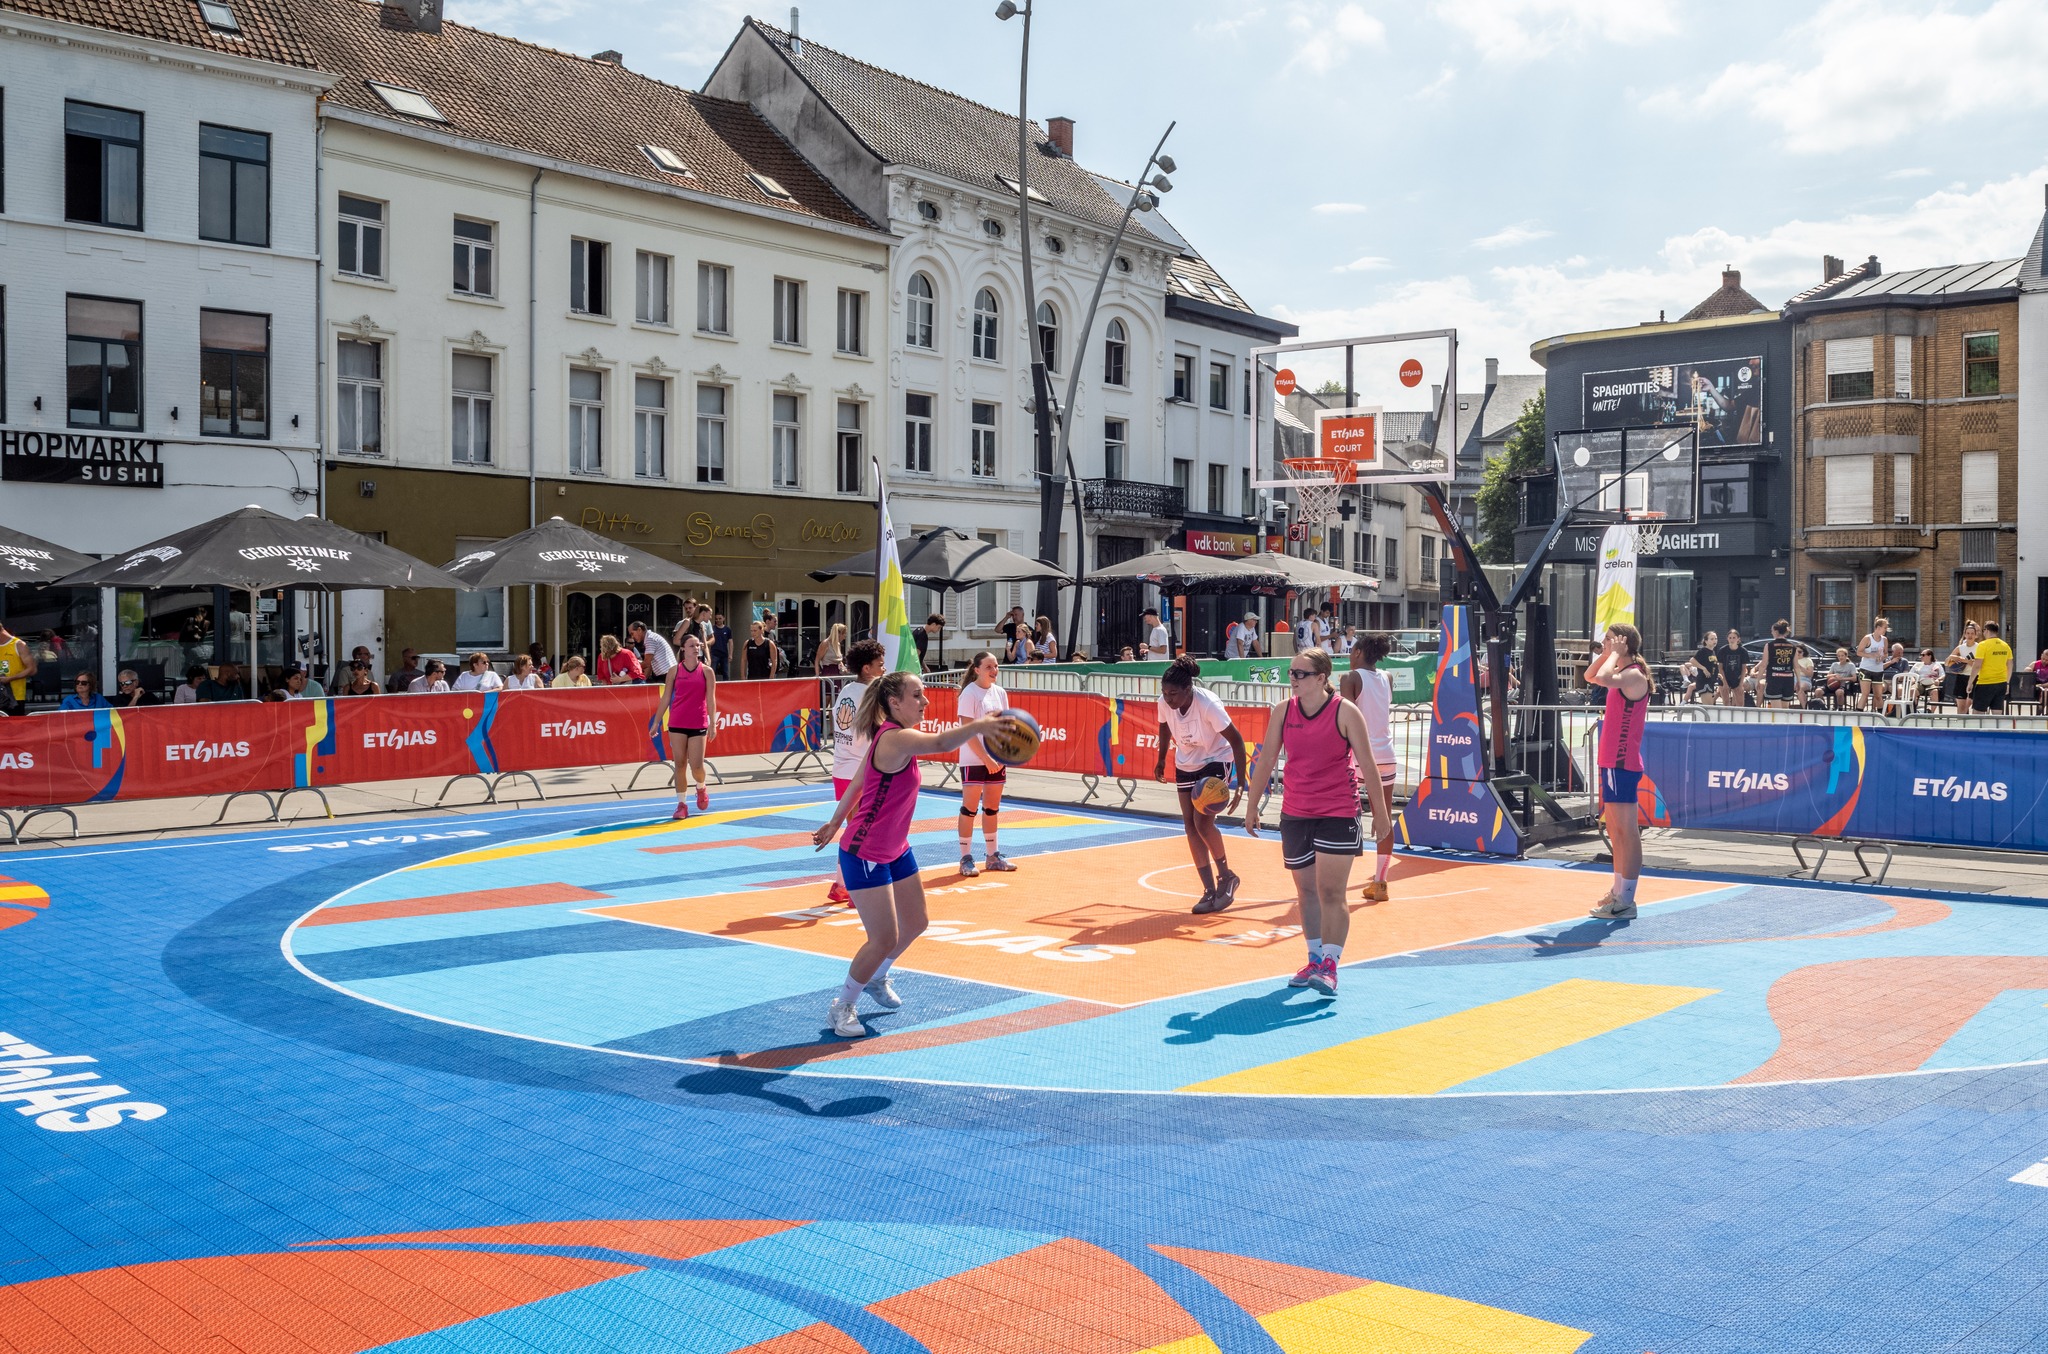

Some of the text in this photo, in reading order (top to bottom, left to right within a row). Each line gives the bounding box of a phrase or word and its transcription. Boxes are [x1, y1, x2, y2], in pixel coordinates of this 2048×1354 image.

[1593, 381, 1660, 397] SPAGHOTTIES
[1593, 398, 1620, 411] UNITE!
[2, 431, 163, 464] HOPMARKT
[1334, 444, 1362, 453] COURT
[82, 465, 158, 482] SUSHI
[1194, 537, 1236, 552] vdk bank
[239, 545, 352, 561] GEROLSTEINER
[538, 550, 628, 564] GEROLSTEINER
[1604, 559, 1633, 569] crelan
[627, 603, 650, 612] OPEN
